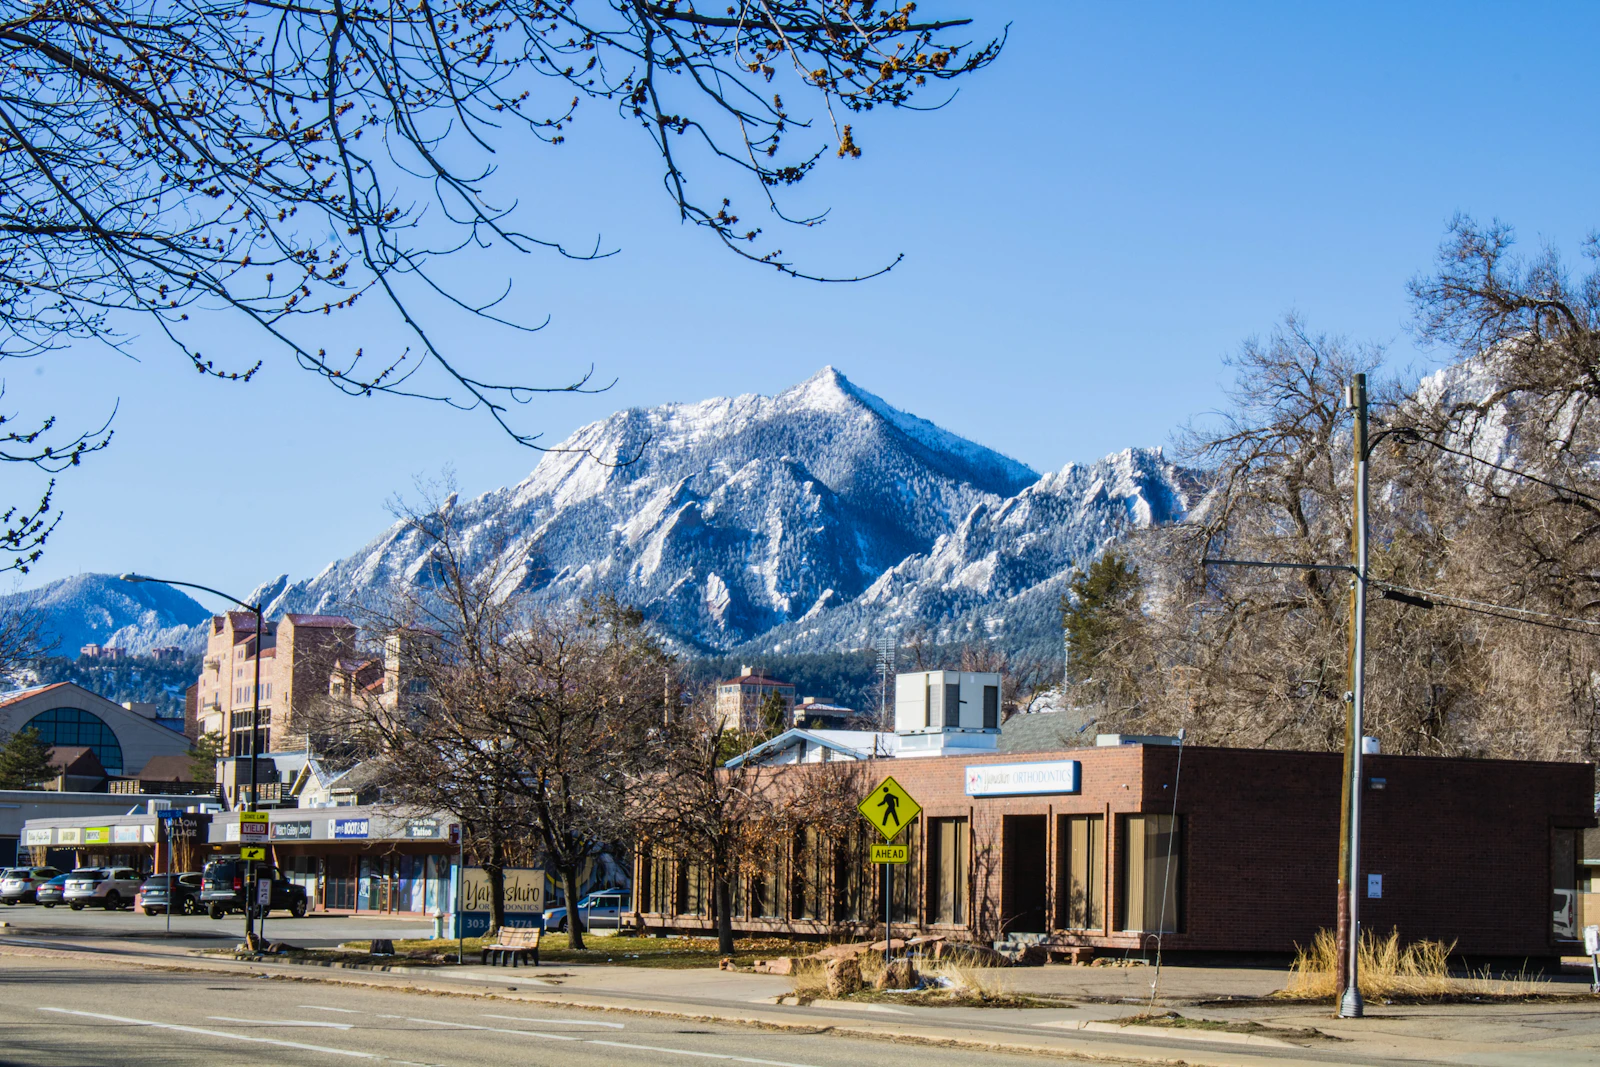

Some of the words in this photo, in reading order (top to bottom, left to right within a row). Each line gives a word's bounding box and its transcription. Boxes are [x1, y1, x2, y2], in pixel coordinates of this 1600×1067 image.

[1012, 769, 1071, 784] ORTHODONTICS
[164, 829, 197, 837] VLLAGE
[245, 824, 265, 833] YIELD
[875, 849, 904, 859] AHEAD
